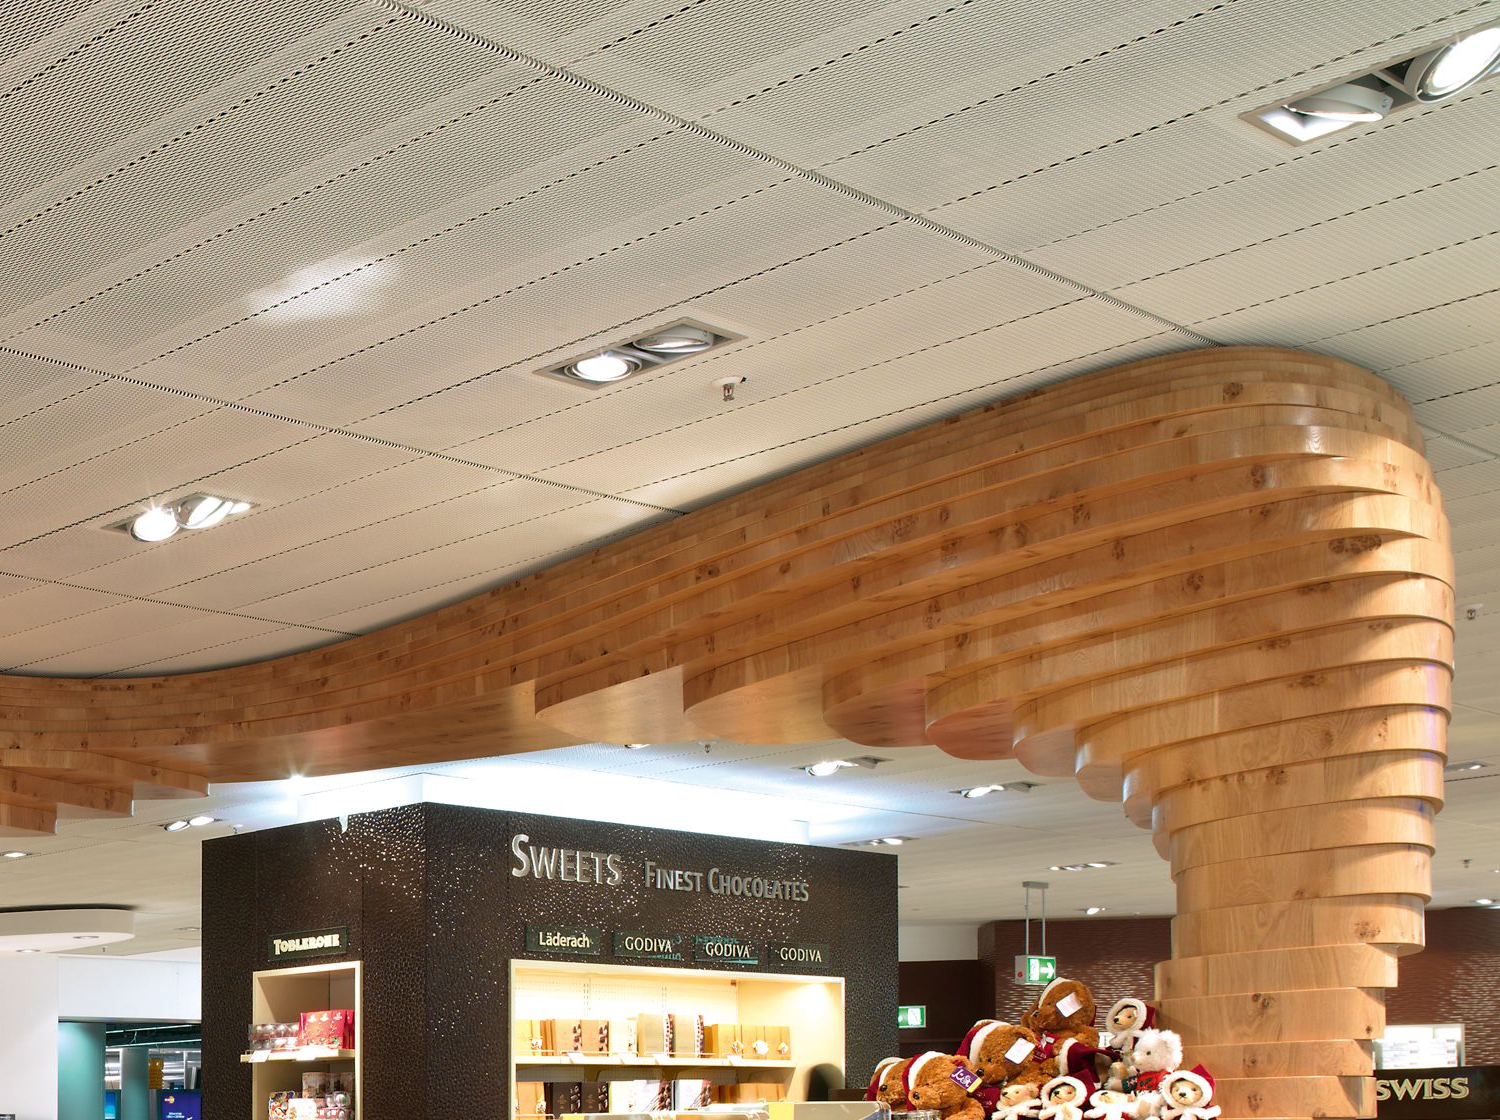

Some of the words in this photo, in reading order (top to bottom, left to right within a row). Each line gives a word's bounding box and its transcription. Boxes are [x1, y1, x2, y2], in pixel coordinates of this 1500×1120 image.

[512, 834, 622, 886] SWEETS
[645, 861, 703, 892] FINEST
[707, 867, 809, 901] CHOCOLATES
[274, 934, 340, 955] TOBLERONE
[540, 932, 590, 948] Läderach
[625, 937, 672, 952] GODIVA
[706, 942, 750, 958] GODIVA
[781, 947, 822, 962] GODIVA
[1376, 1077, 1470, 1101] SWISS
